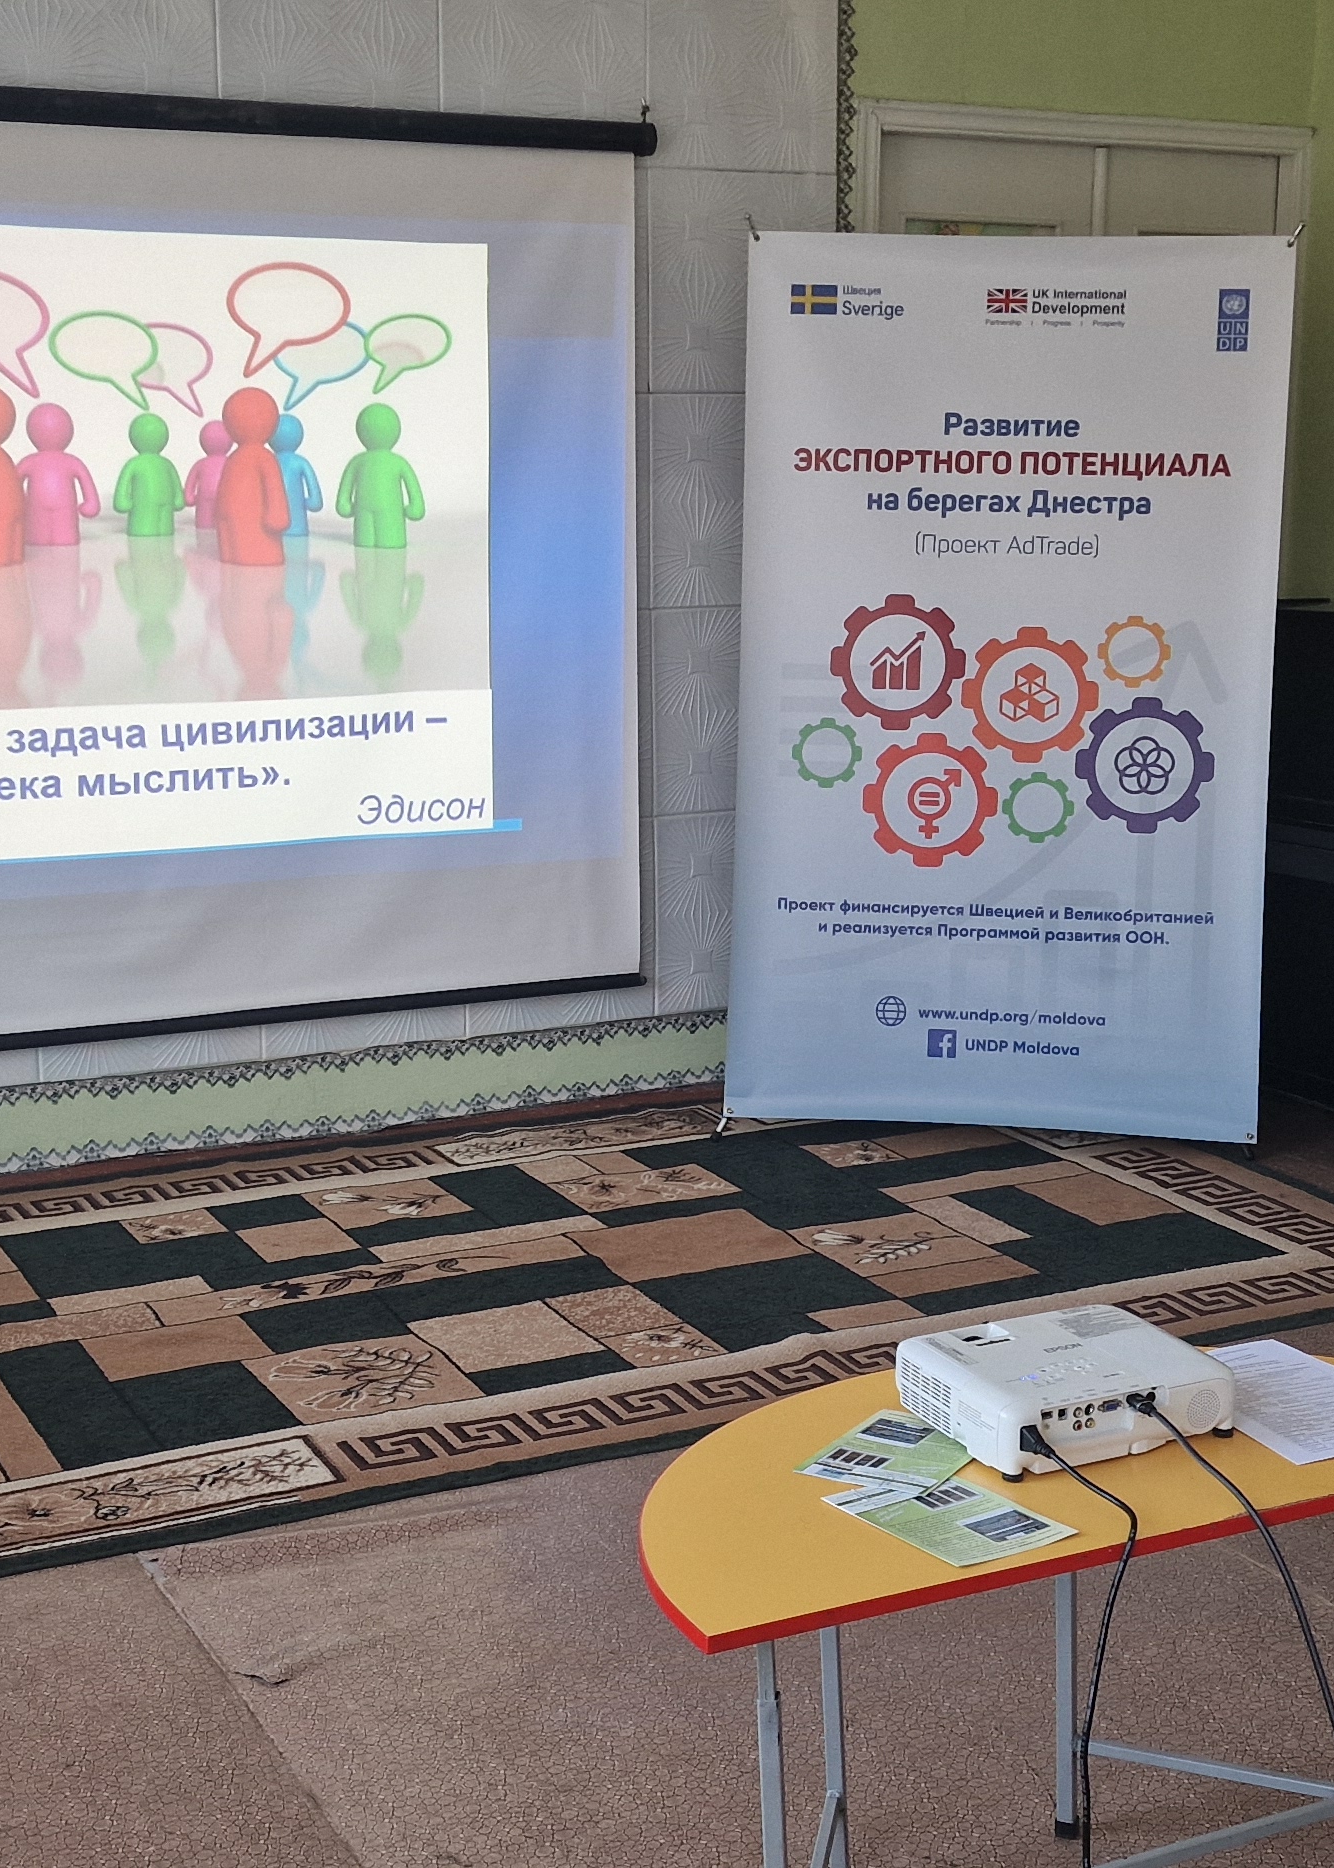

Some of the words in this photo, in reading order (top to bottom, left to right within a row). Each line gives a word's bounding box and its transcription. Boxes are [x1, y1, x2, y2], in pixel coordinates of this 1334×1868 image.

[1031, 288, 1049, 299] UK
[1052, 288, 1126, 299] International
[841, 299, 904, 320] Sverige
[1031, 300, 1125, 317] Development
[943, 411, 1080, 437] Развитие
[794, 447, 1011, 474] ЭКСПОРТНОГО
[1019, 451, 1230, 480] ПОТЕНЦИАЛА
[866, 492, 899, 510] на
[907, 486, 1020, 518] берегах
[1026, 489, 1151, 521] Днестра
[915, 530, 1000, 558] (Проект
[1006, 533, 1099, 558] AdTrade)
[6, 724, 146, 757] задача
[160, 710, 413, 751] цивилизации
[77, 766, 289, 796] мыслить».
[357, 794, 486, 826] Эдисон
[777, 896, 835, 913] Проект
[839, 899, 964, 917] финансируется
[968, 903, 1044, 920] Швецией
[1049, 909, 1059, 919] и
[1063, 906, 1213, 925] Великобританией
[817, 922, 827, 932] и
[831, 923, 932, 937] реализуется
[937, 923, 1039, 941] Программой
[1044, 930, 1120, 943] развития
[1125, 930, 1169, 945] ООН.
[918, 1008, 1105, 1026] www.undp.org/moldova
[964, 1038, 1008, 1052] UNDP
[1012, 1040, 1079, 1056] Moldova
